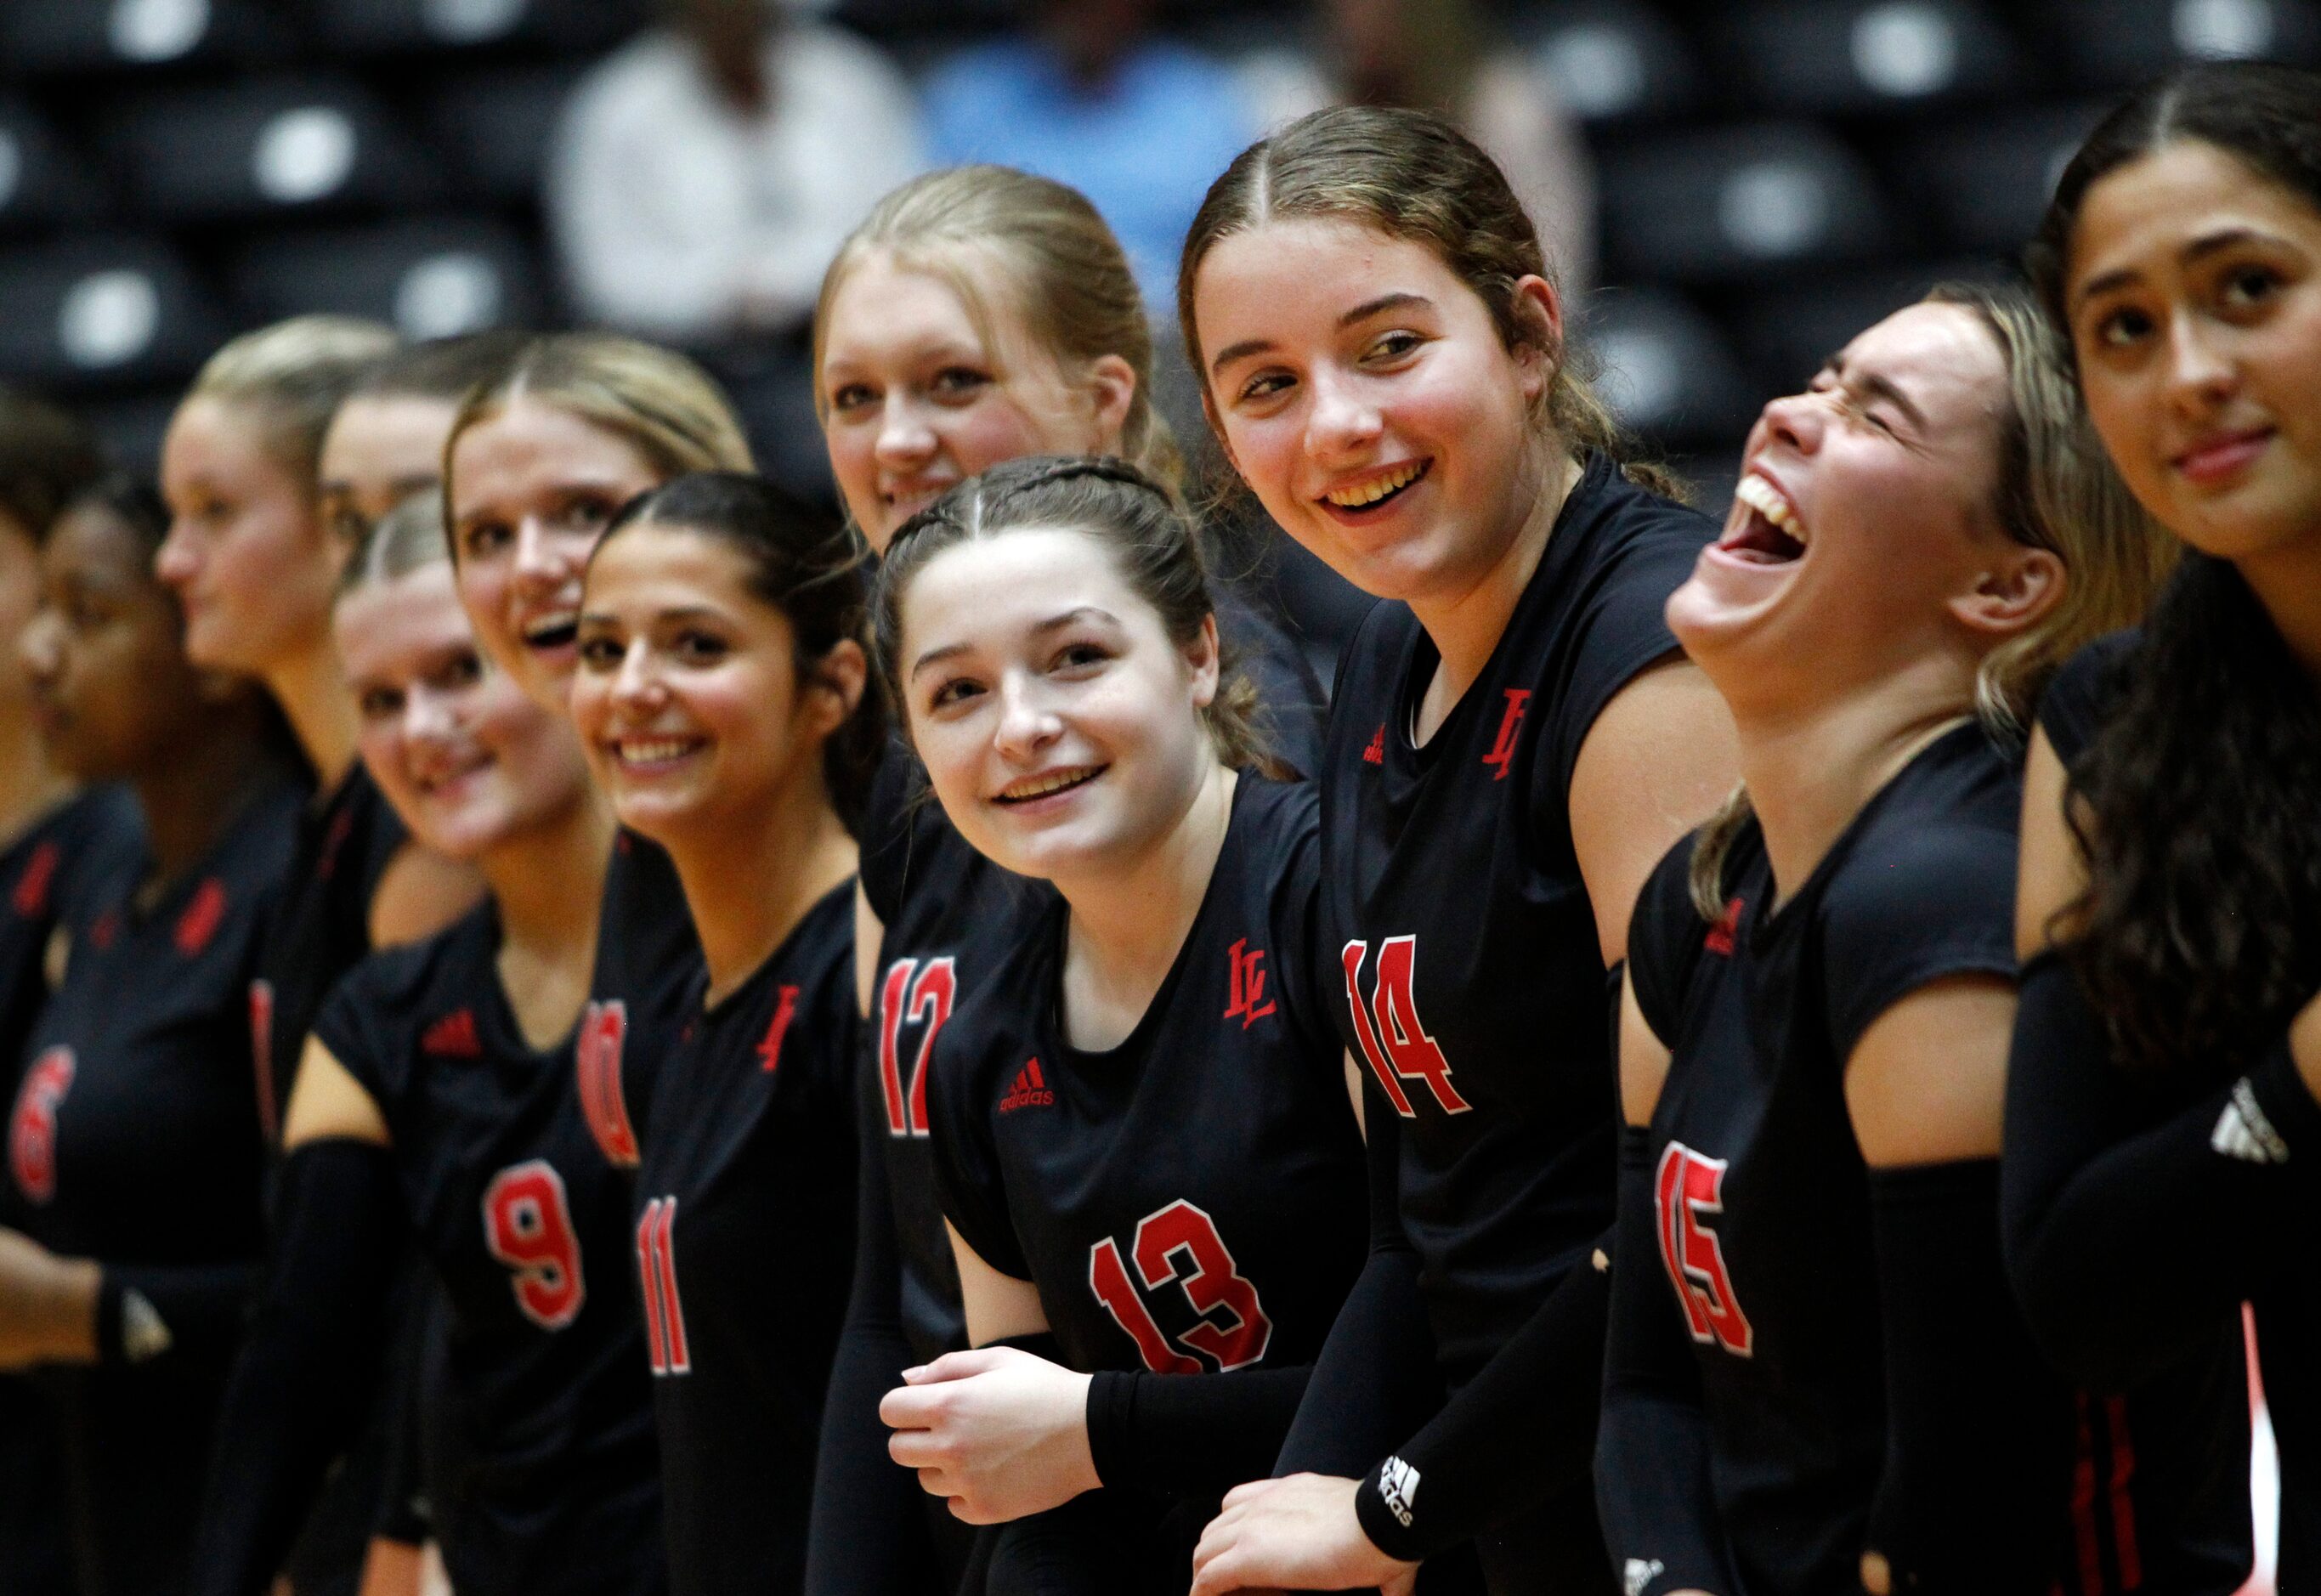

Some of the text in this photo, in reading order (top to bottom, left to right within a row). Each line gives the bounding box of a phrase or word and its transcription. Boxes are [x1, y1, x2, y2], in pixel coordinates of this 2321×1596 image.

[880, 956, 957, 1139] 12
[999, 1088, 1055, 1113] adidas
[1342, 934, 1474, 1118] 14
[484, 1159, 585, 1330] 9
[638, 1196, 690, 1375] 11
[1090, 1197, 1272, 1374] 13
[1655, 1140, 1753, 1359] 15
